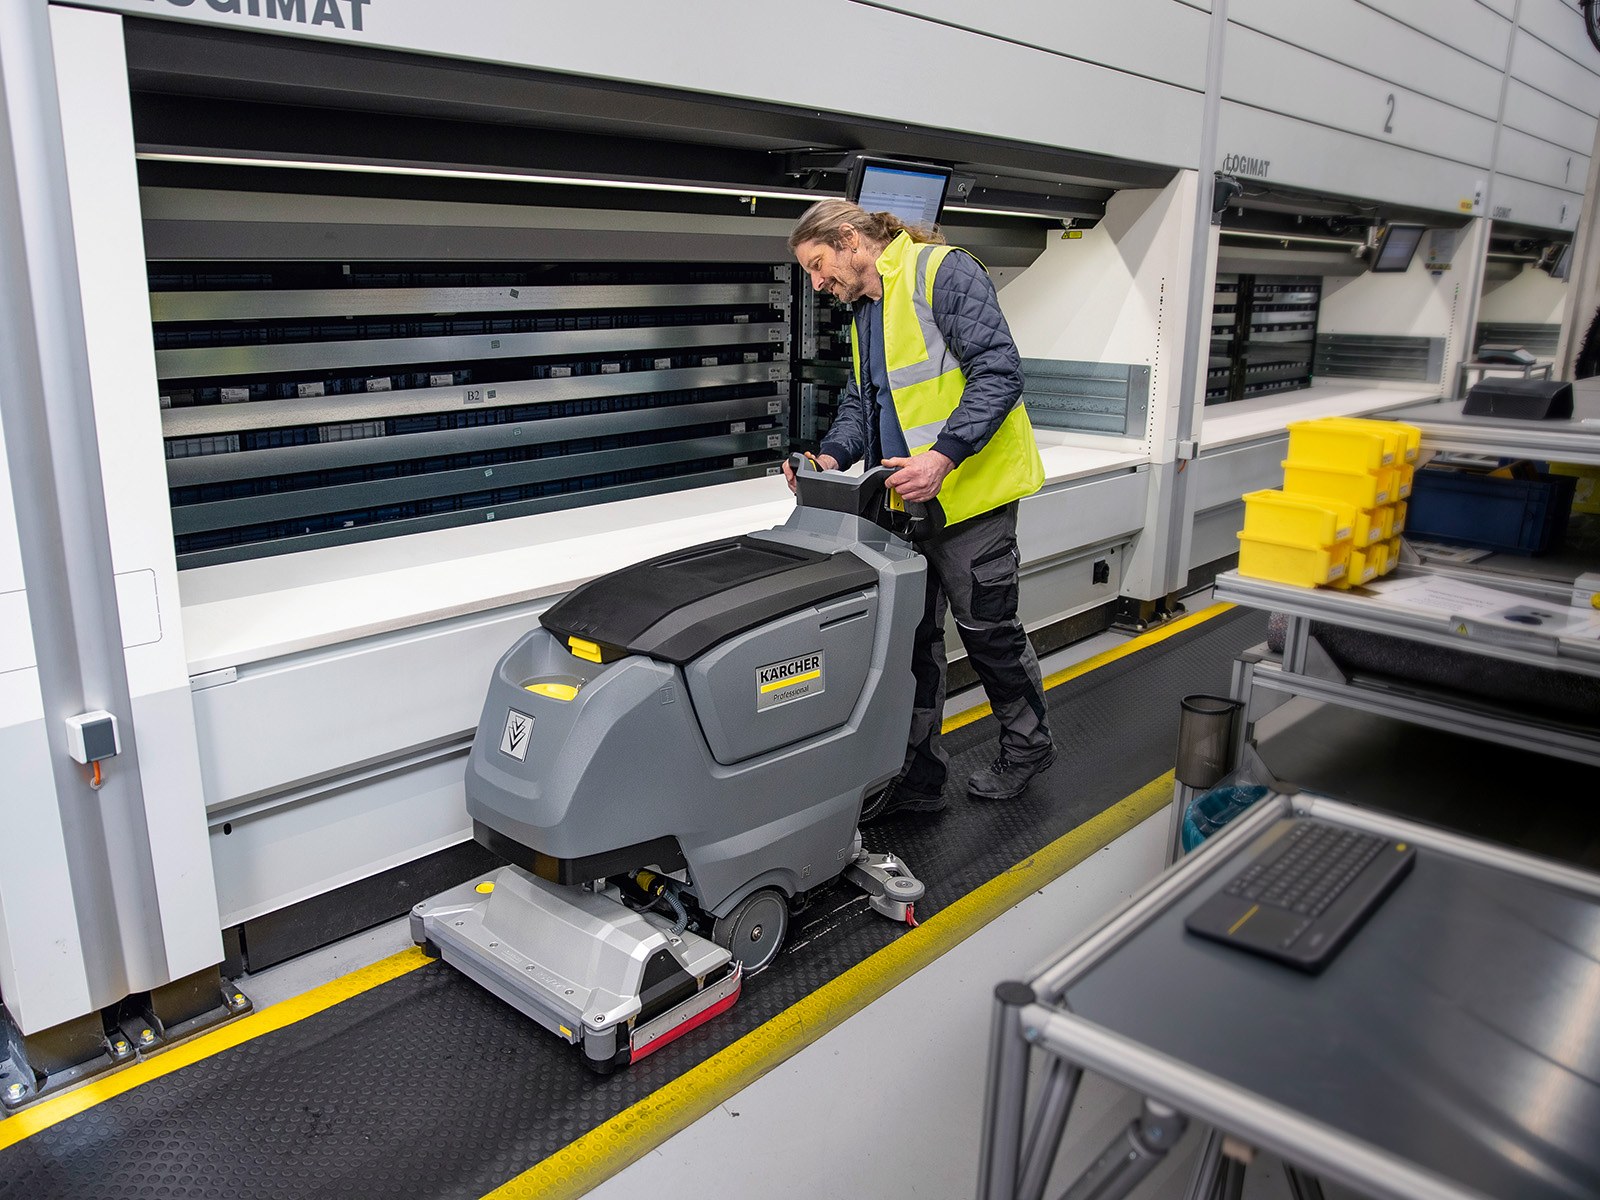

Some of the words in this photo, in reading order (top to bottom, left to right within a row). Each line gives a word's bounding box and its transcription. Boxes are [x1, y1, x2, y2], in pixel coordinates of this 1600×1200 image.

[138, 0, 371, 32] IMAT
[1384, 93, 1395, 134] 2
[1225, 153, 1271, 178] LOGIMAT
[467, 390, 480, 401] B2
[760, 656, 820, 683] KÄRCHER
[773, 685, 810, 701] Professional
